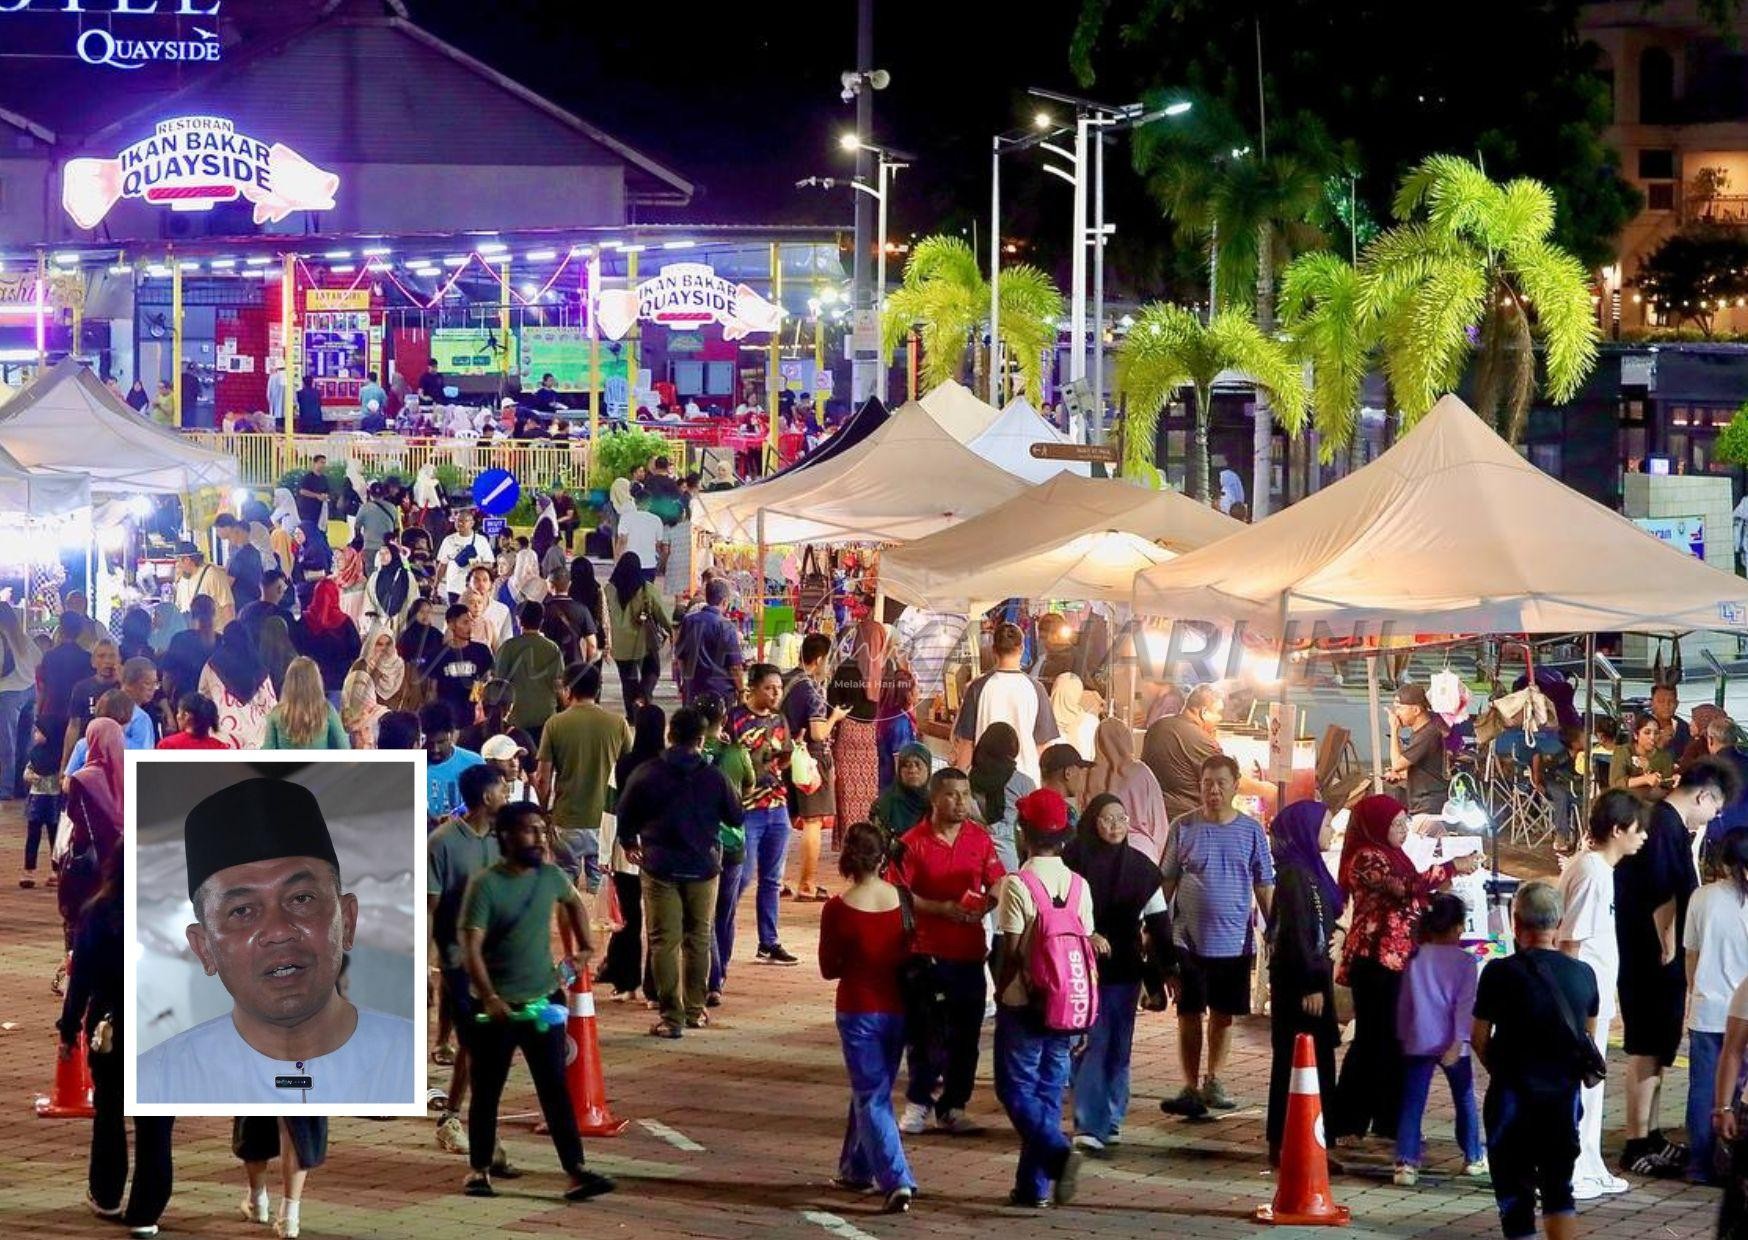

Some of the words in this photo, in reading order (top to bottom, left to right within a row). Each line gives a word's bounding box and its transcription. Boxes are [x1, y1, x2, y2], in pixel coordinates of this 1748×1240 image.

[77, 28, 220, 69] QUAYSIDE
[157, 118, 233, 133] RESTORAN
[121, 134, 177, 172] IKAN
[187, 132, 270, 166] BAKAR
[123, 155, 272, 194] QUAYSIDE
[639, 276, 676, 298] IKAN
[683, 275, 737, 297] BAKAR
[640, 290, 737, 317] QUAYSIDE
[1068, 950, 1089, 1029] adidas
